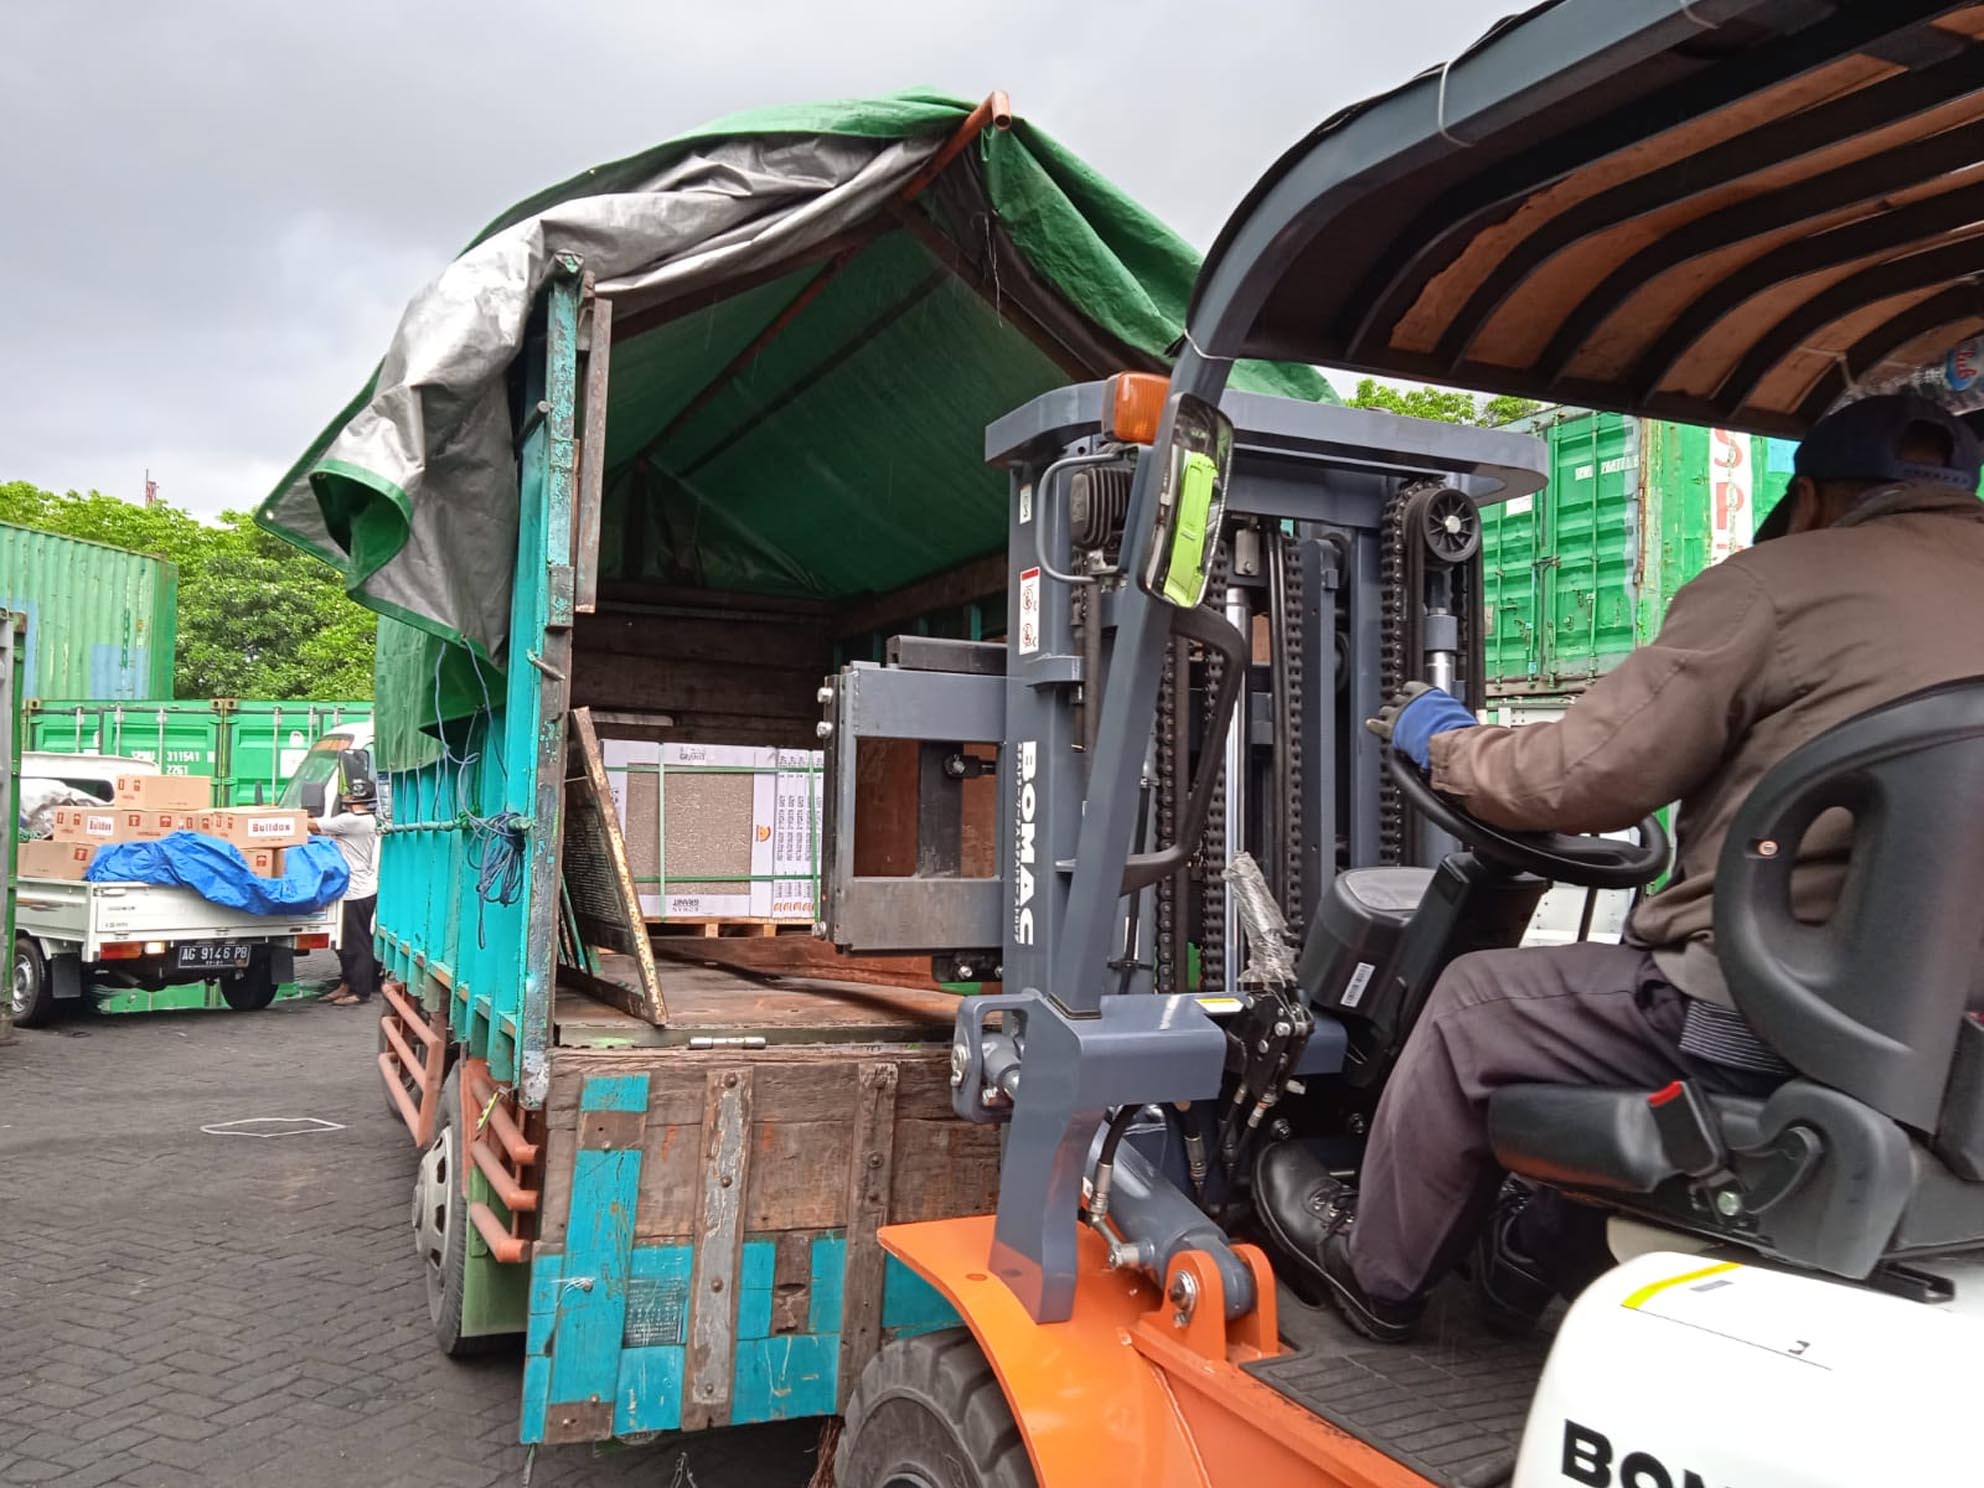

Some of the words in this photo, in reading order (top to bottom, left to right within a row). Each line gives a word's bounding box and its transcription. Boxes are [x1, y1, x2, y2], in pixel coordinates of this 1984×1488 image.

[1019, 741, 1037, 945] BOMAC
[182, 948, 196, 960] AG
[201, 947, 231, 960] 9146
